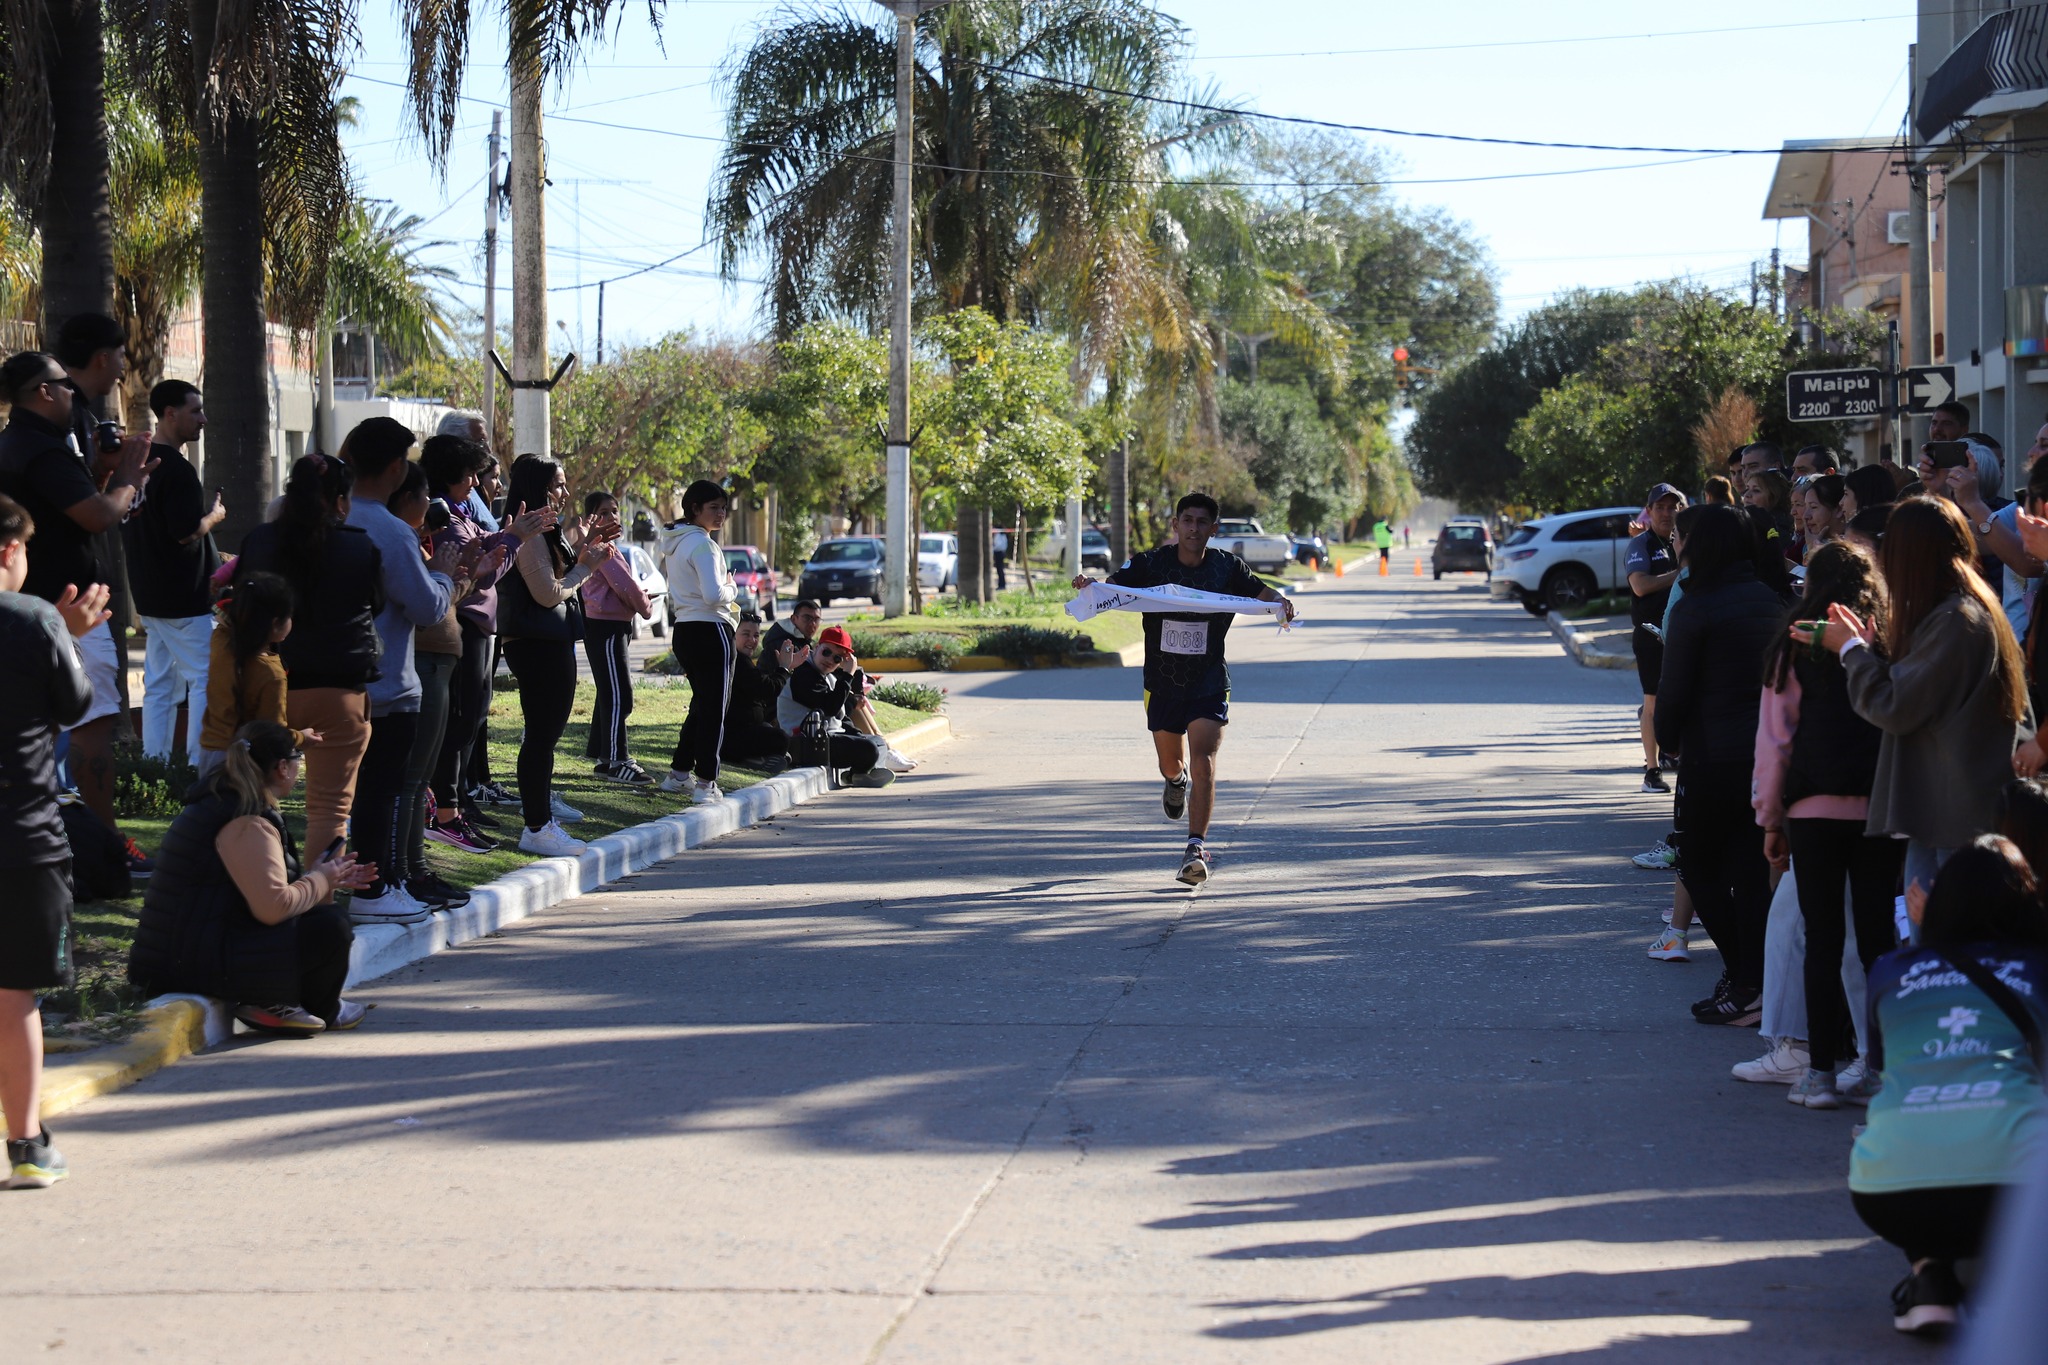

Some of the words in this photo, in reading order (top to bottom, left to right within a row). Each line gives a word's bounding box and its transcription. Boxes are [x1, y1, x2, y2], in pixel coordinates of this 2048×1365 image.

[1804, 375, 1870, 393] Maipú
[1798, 402, 1831, 417] 2200
[1845, 399, 1877, 414] 2300
[1166, 629, 1204, 649] 068
[1902, 1080, 2003, 1104] 299
